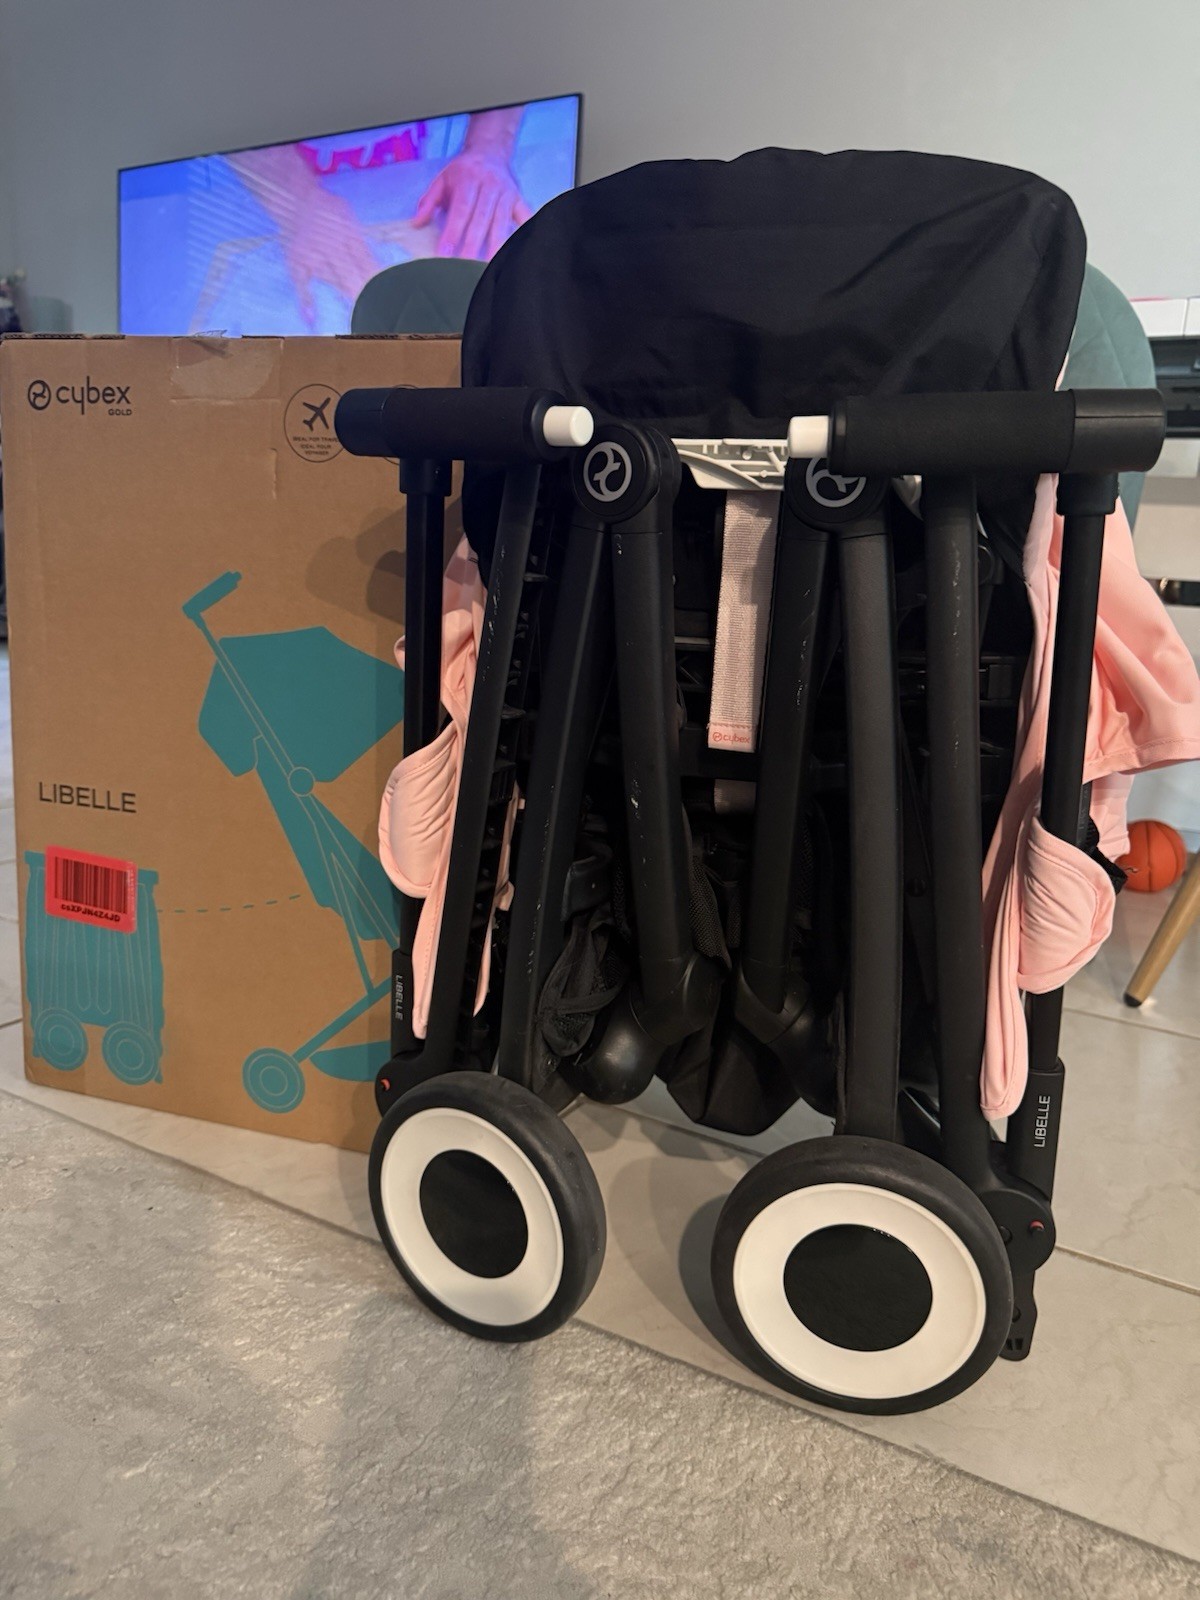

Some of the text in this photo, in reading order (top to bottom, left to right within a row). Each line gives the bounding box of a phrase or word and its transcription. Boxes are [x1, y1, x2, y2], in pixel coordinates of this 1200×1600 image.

[56, 376, 131, 415] cybex
[723, 733, 750, 744] cybex
[39, 782, 137, 813] LIBELLE
[395, 975, 404, 1020] LIBELLE
[1034, 1096, 1051, 1147] LIBELLE
